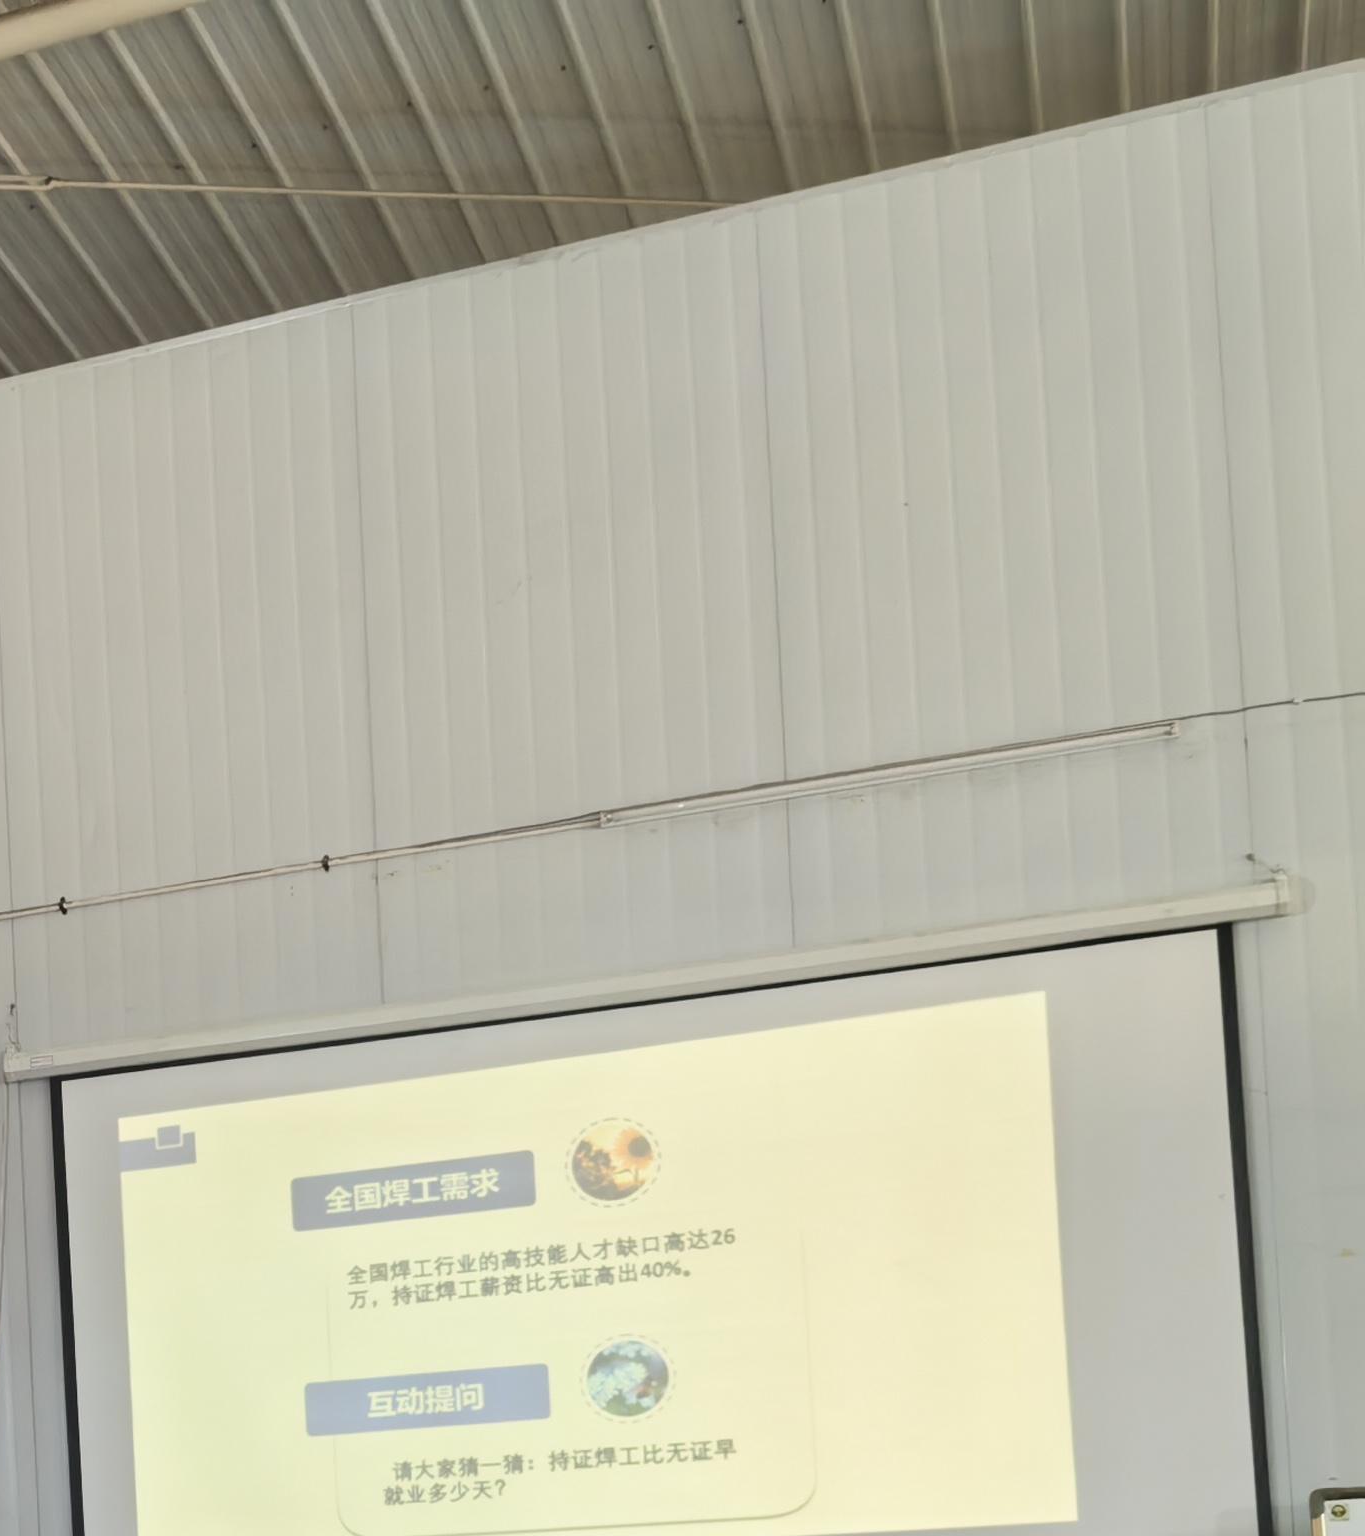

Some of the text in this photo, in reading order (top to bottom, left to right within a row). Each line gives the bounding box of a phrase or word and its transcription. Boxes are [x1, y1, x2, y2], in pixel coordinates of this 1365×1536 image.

[325, 1168, 500, 1214] 全国焊工需求
[346, 1228, 736, 1287] 全国焊工行业的高技能人才缺口高达26
[367, 1382, 486, 1418] 互动提问
